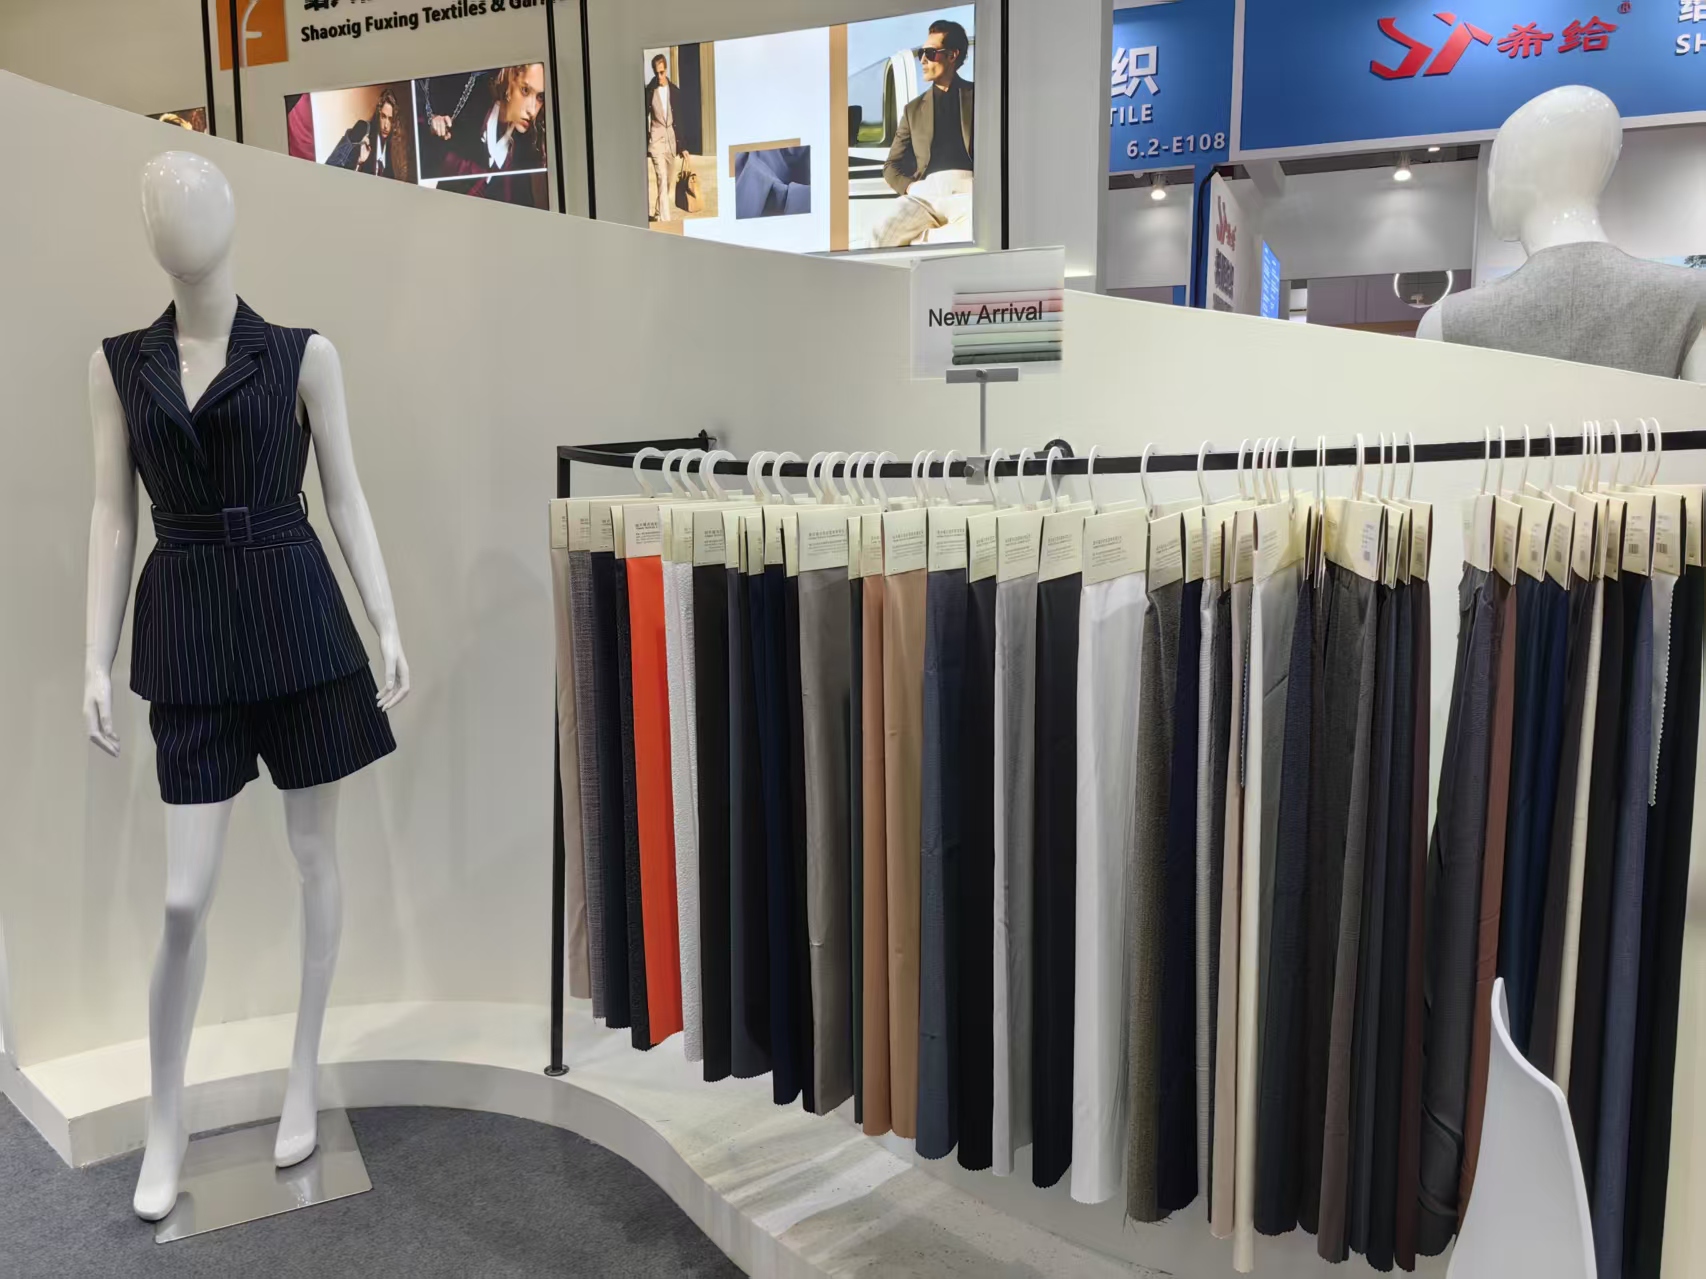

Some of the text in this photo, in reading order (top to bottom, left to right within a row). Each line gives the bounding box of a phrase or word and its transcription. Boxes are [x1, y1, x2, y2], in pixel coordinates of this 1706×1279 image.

[301, 18, 361, 42] Shaoxig
[365, 11, 419, 32] Fuxing
[422, 0, 487, 23] Textiles
[1497, 15, 1618, 58] 希给
[1126, 131, 1226, 158] 6.2-E108
[928, 300, 1043, 328] New Arrival
